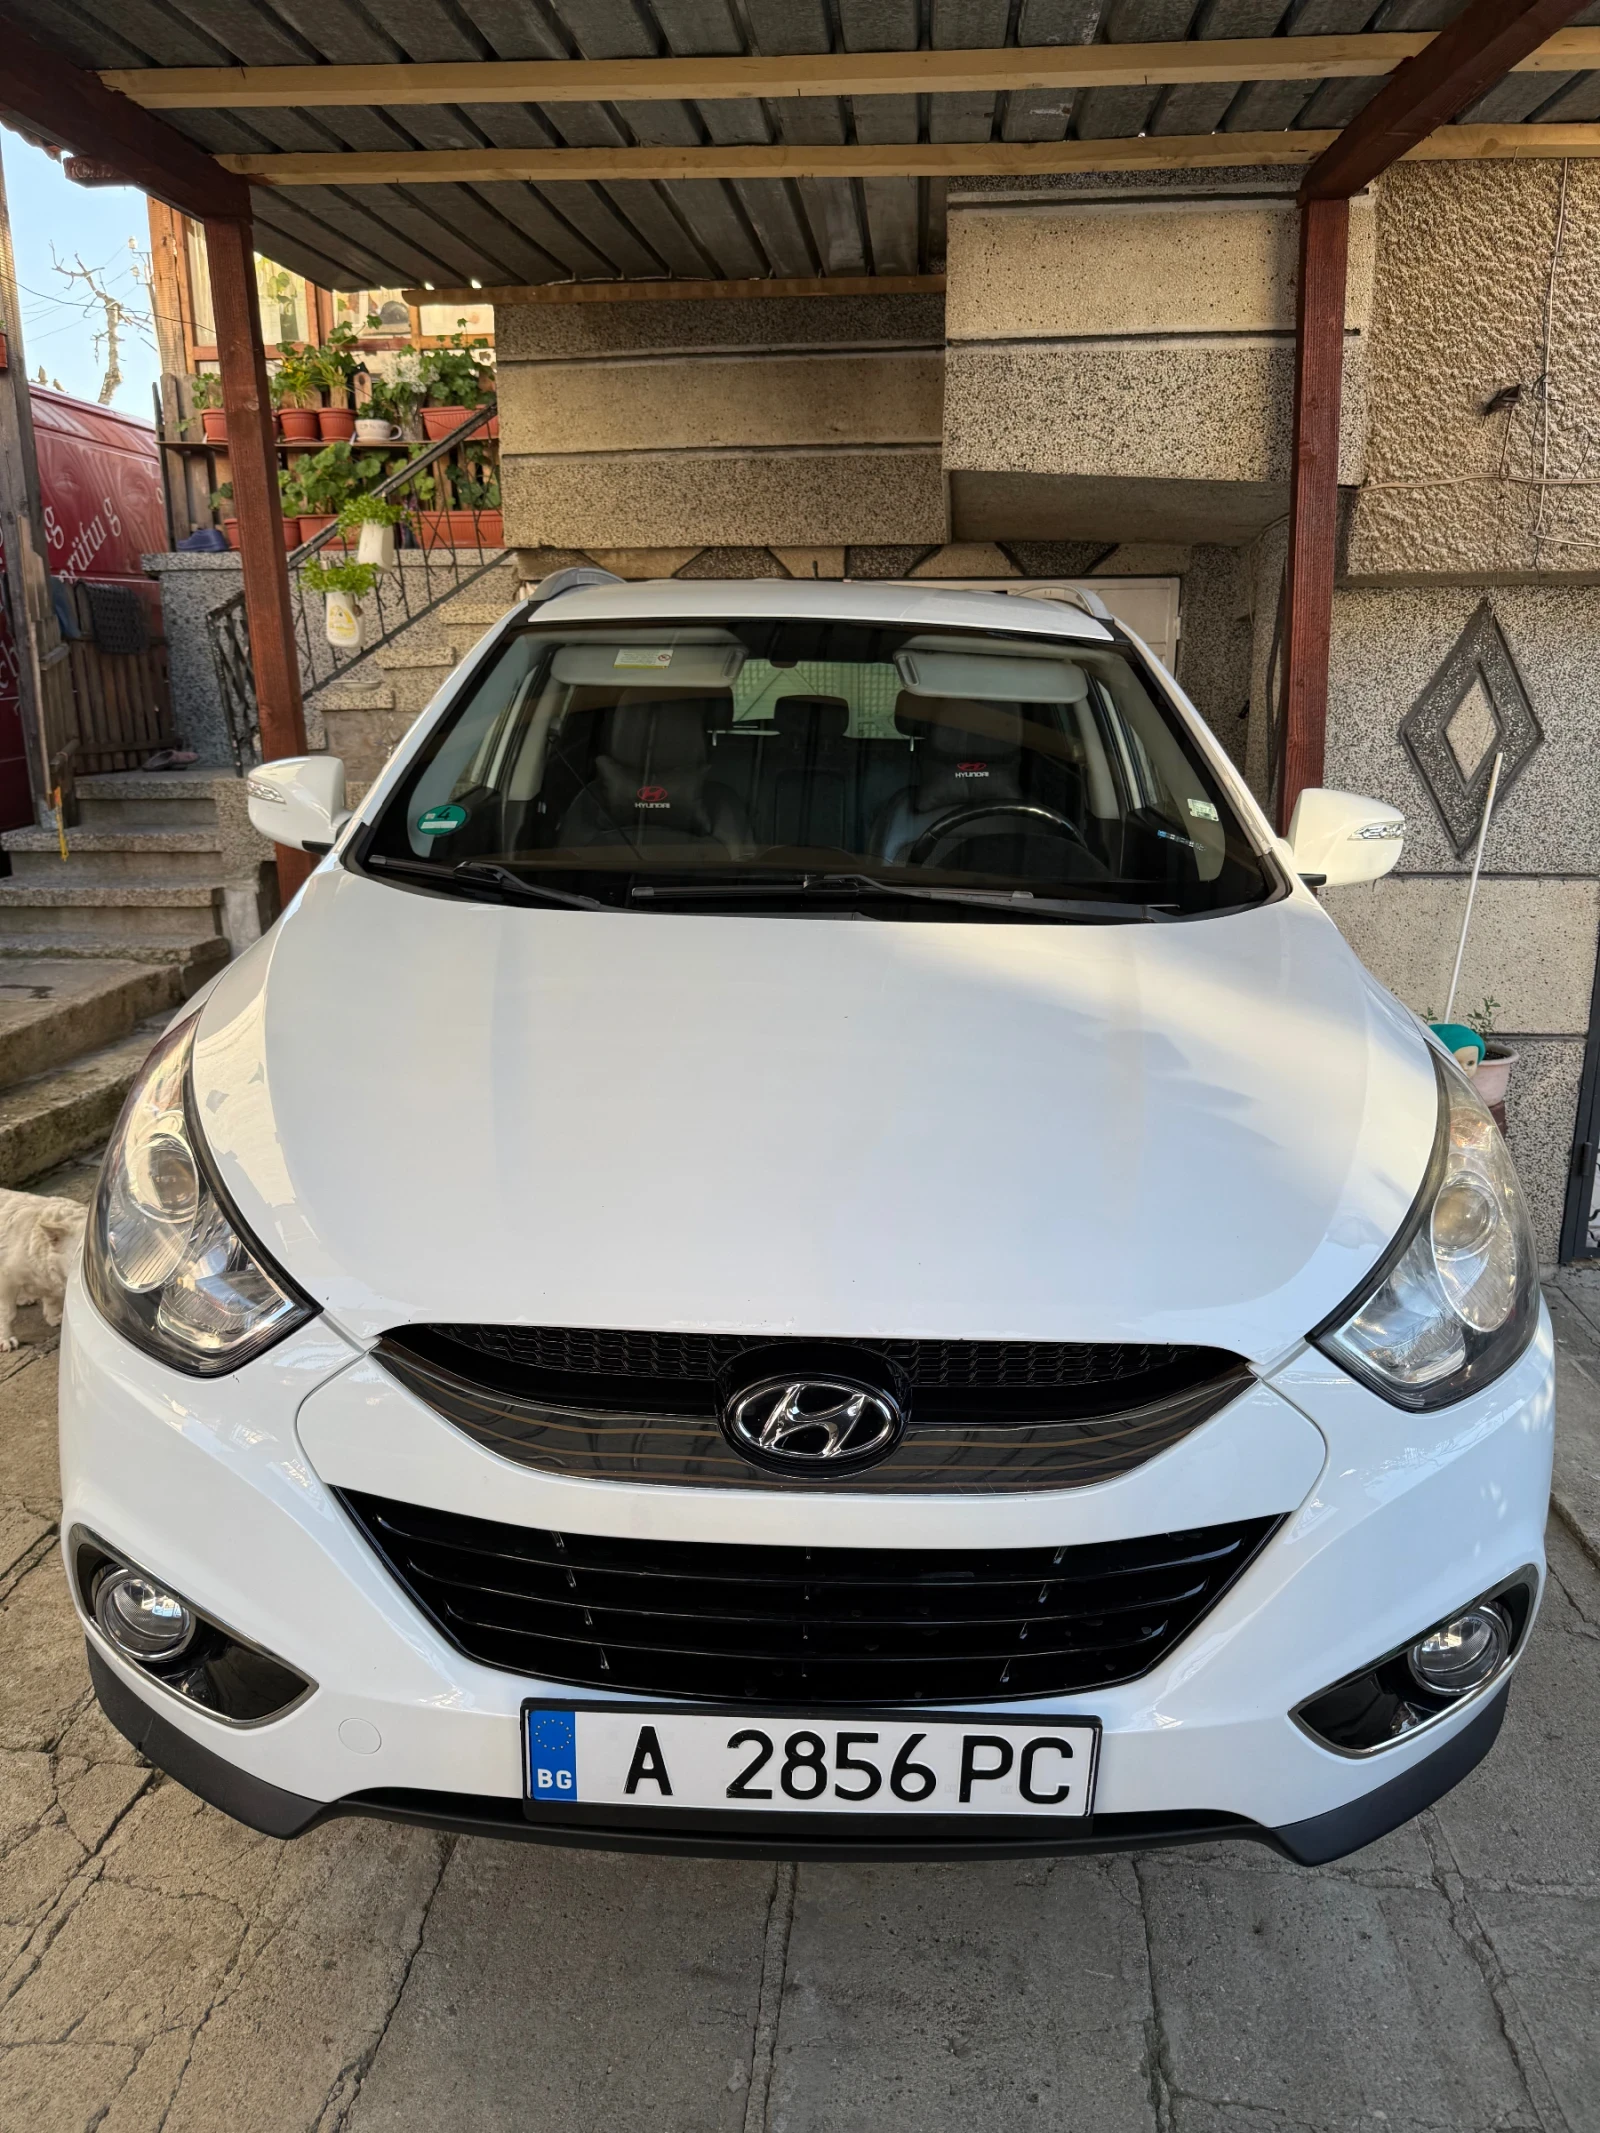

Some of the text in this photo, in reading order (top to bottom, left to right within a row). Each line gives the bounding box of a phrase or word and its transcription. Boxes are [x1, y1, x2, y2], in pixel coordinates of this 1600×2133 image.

[437, 807, 453, 820] 4
[624, 1725, 1074, 1804] A 2856 PC
[537, 1768, 572, 1789] BG
